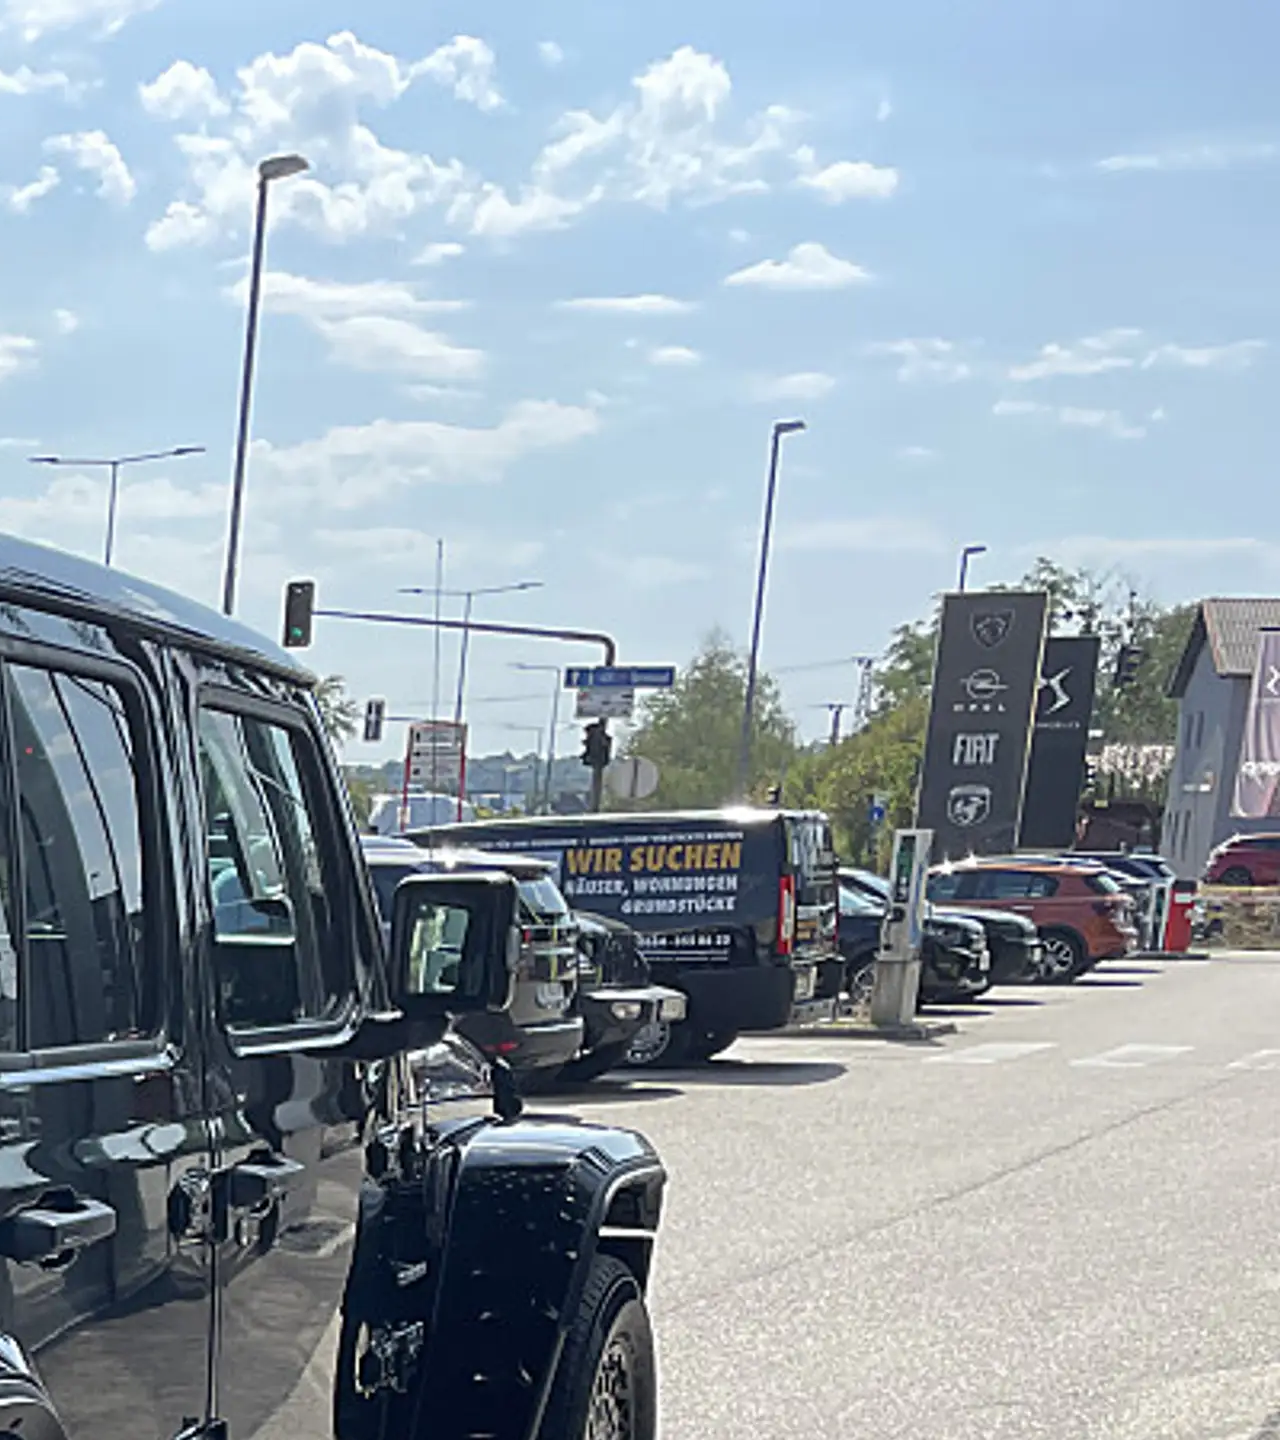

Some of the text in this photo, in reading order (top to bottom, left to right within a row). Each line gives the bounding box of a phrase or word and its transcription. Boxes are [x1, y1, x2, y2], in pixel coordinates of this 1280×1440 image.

[952, 732, 1000, 766] FIAT
[565, 841, 743, 875] WIR SUCHEN
